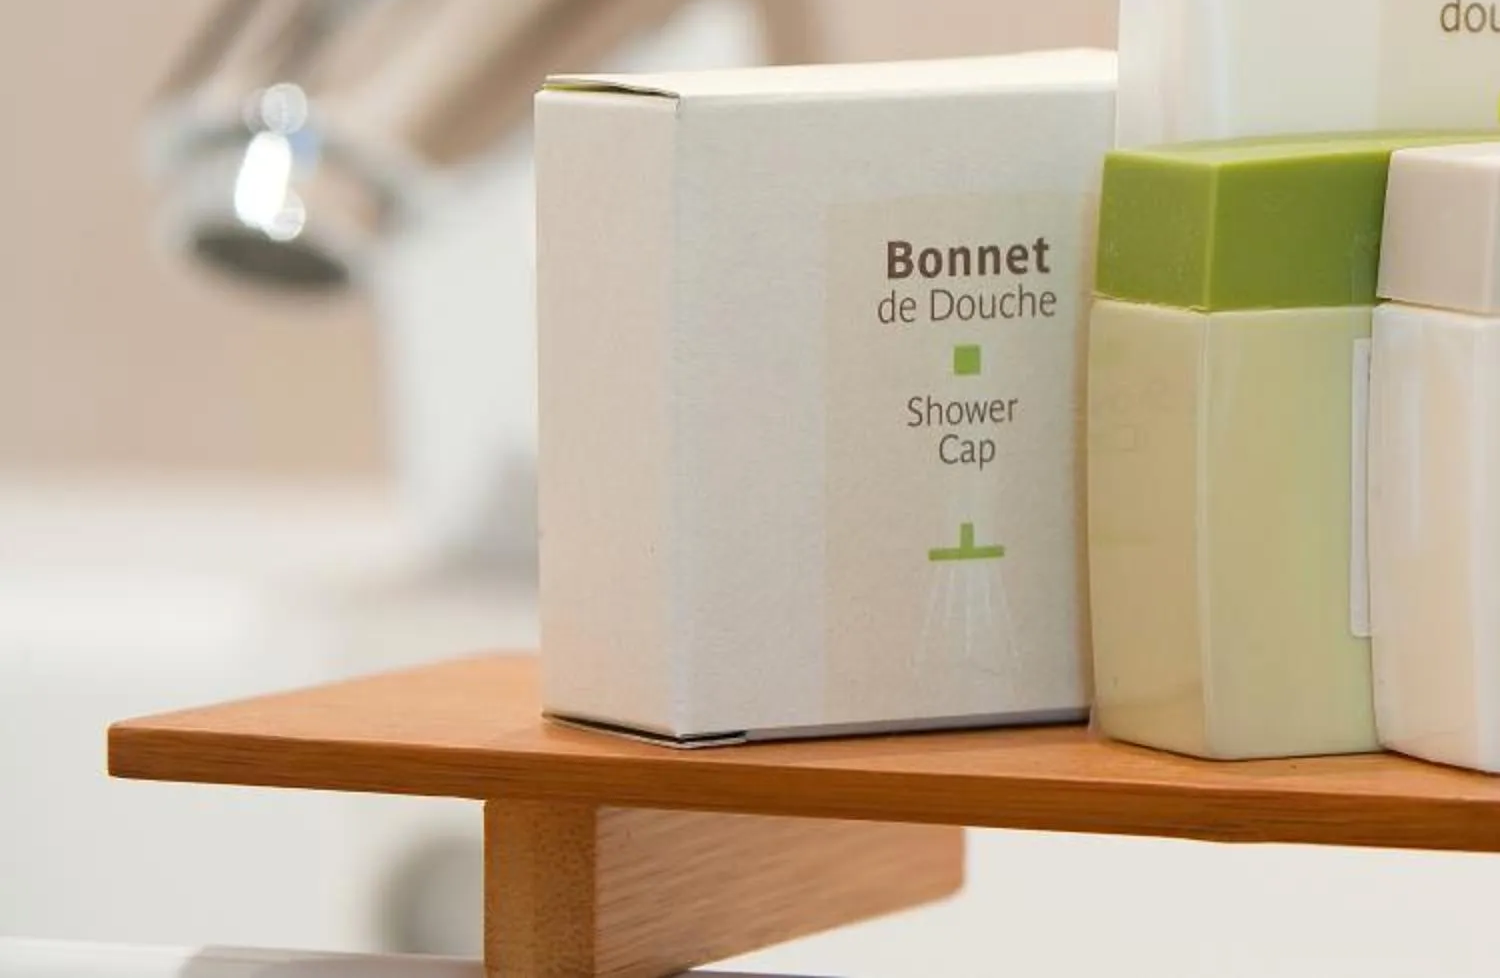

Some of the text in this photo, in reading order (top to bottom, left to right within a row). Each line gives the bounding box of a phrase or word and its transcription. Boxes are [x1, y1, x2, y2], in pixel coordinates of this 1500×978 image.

[886, 237, 1051, 280] Bonnet
[877, 284, 1057, 324] de Douche
[907, 395, 1019, 428] Shower
[938, 433, 996, 471] Cap
